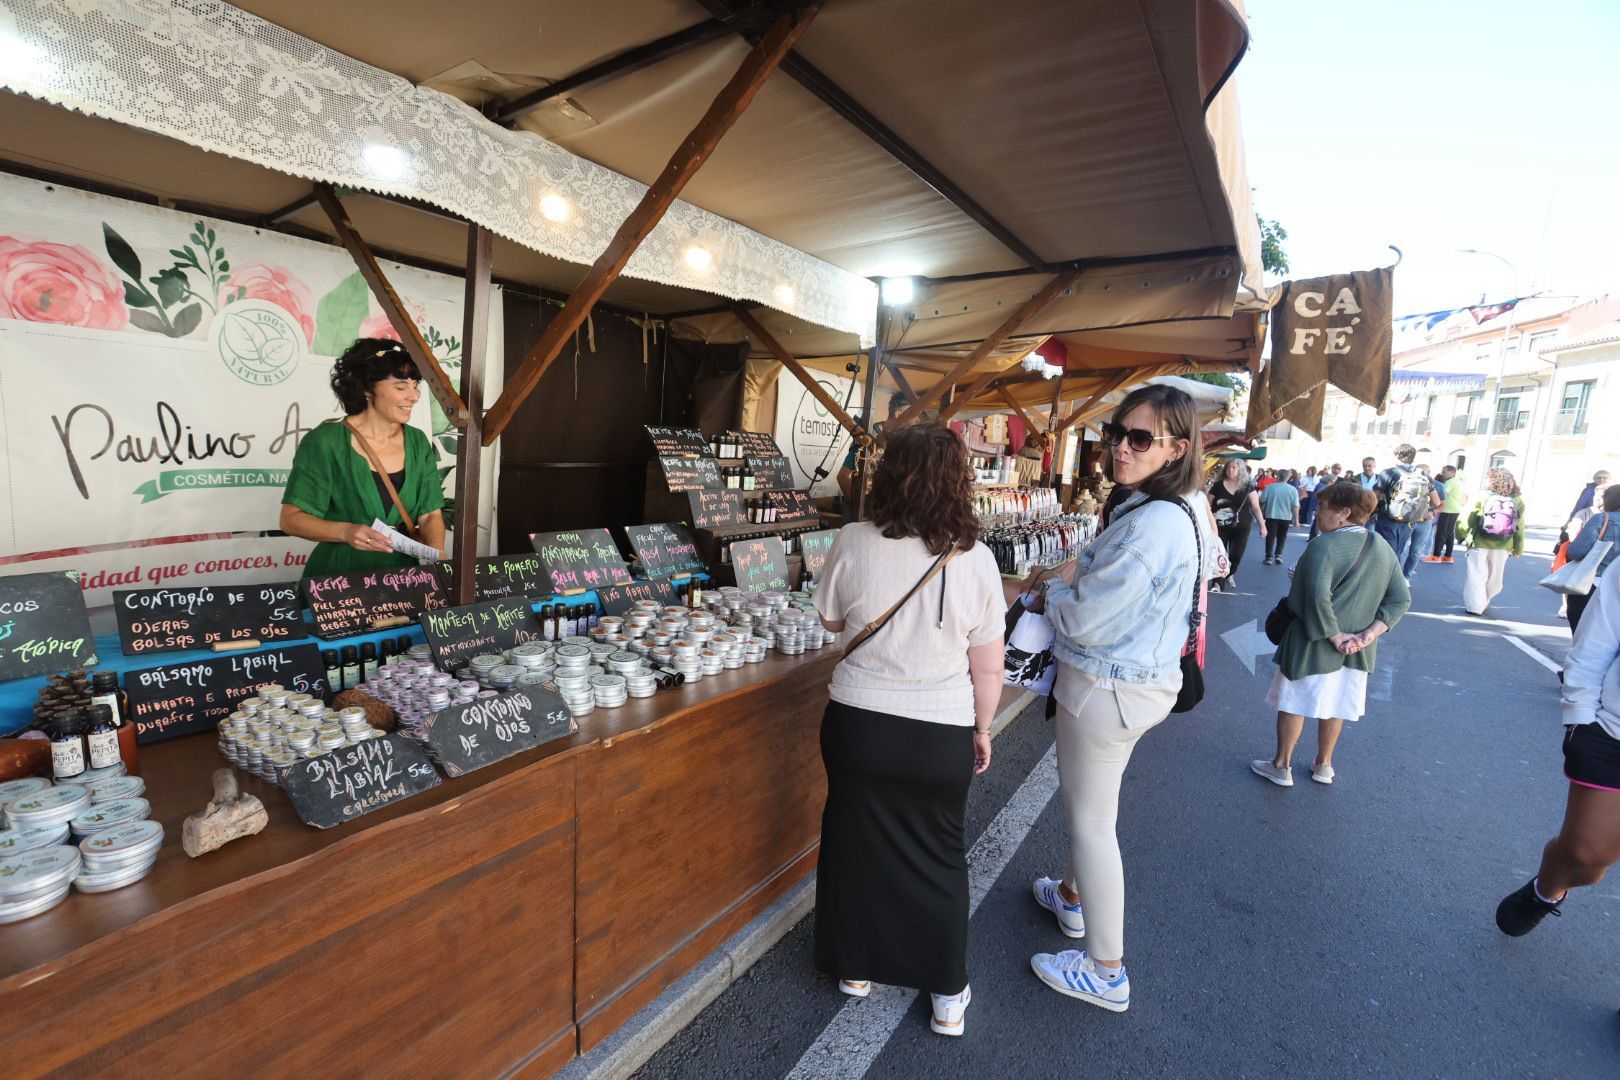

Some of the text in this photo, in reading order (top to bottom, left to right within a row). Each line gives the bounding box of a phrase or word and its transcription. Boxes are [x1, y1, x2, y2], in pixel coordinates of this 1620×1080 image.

[51, 401, 256, 500] Paulino
[174, 471, 291, 487] COSMÉTICA NA
[147, 563, 190, 585] que
[194, 554, 279, 574] conoces,
[228, 592, 245, 605] DE
[269, 608, 298, 621] 5€
[132, 635, 195, 650] BOLSAS
[205, 632, 221, 643] DE
[139, 666, 214, 688] BÁLSAMO
[292, 673, 325, 694] 5€
[205, 693, 215, 702] E
[461, 692, 532, 730] CONTORNO
[546, 710, 567, 725] 5€
[459, 733, 480, 757] DE
[306, 740, 393, 785] BÁLSAMO
[407, 762, 433, 778] 5€
